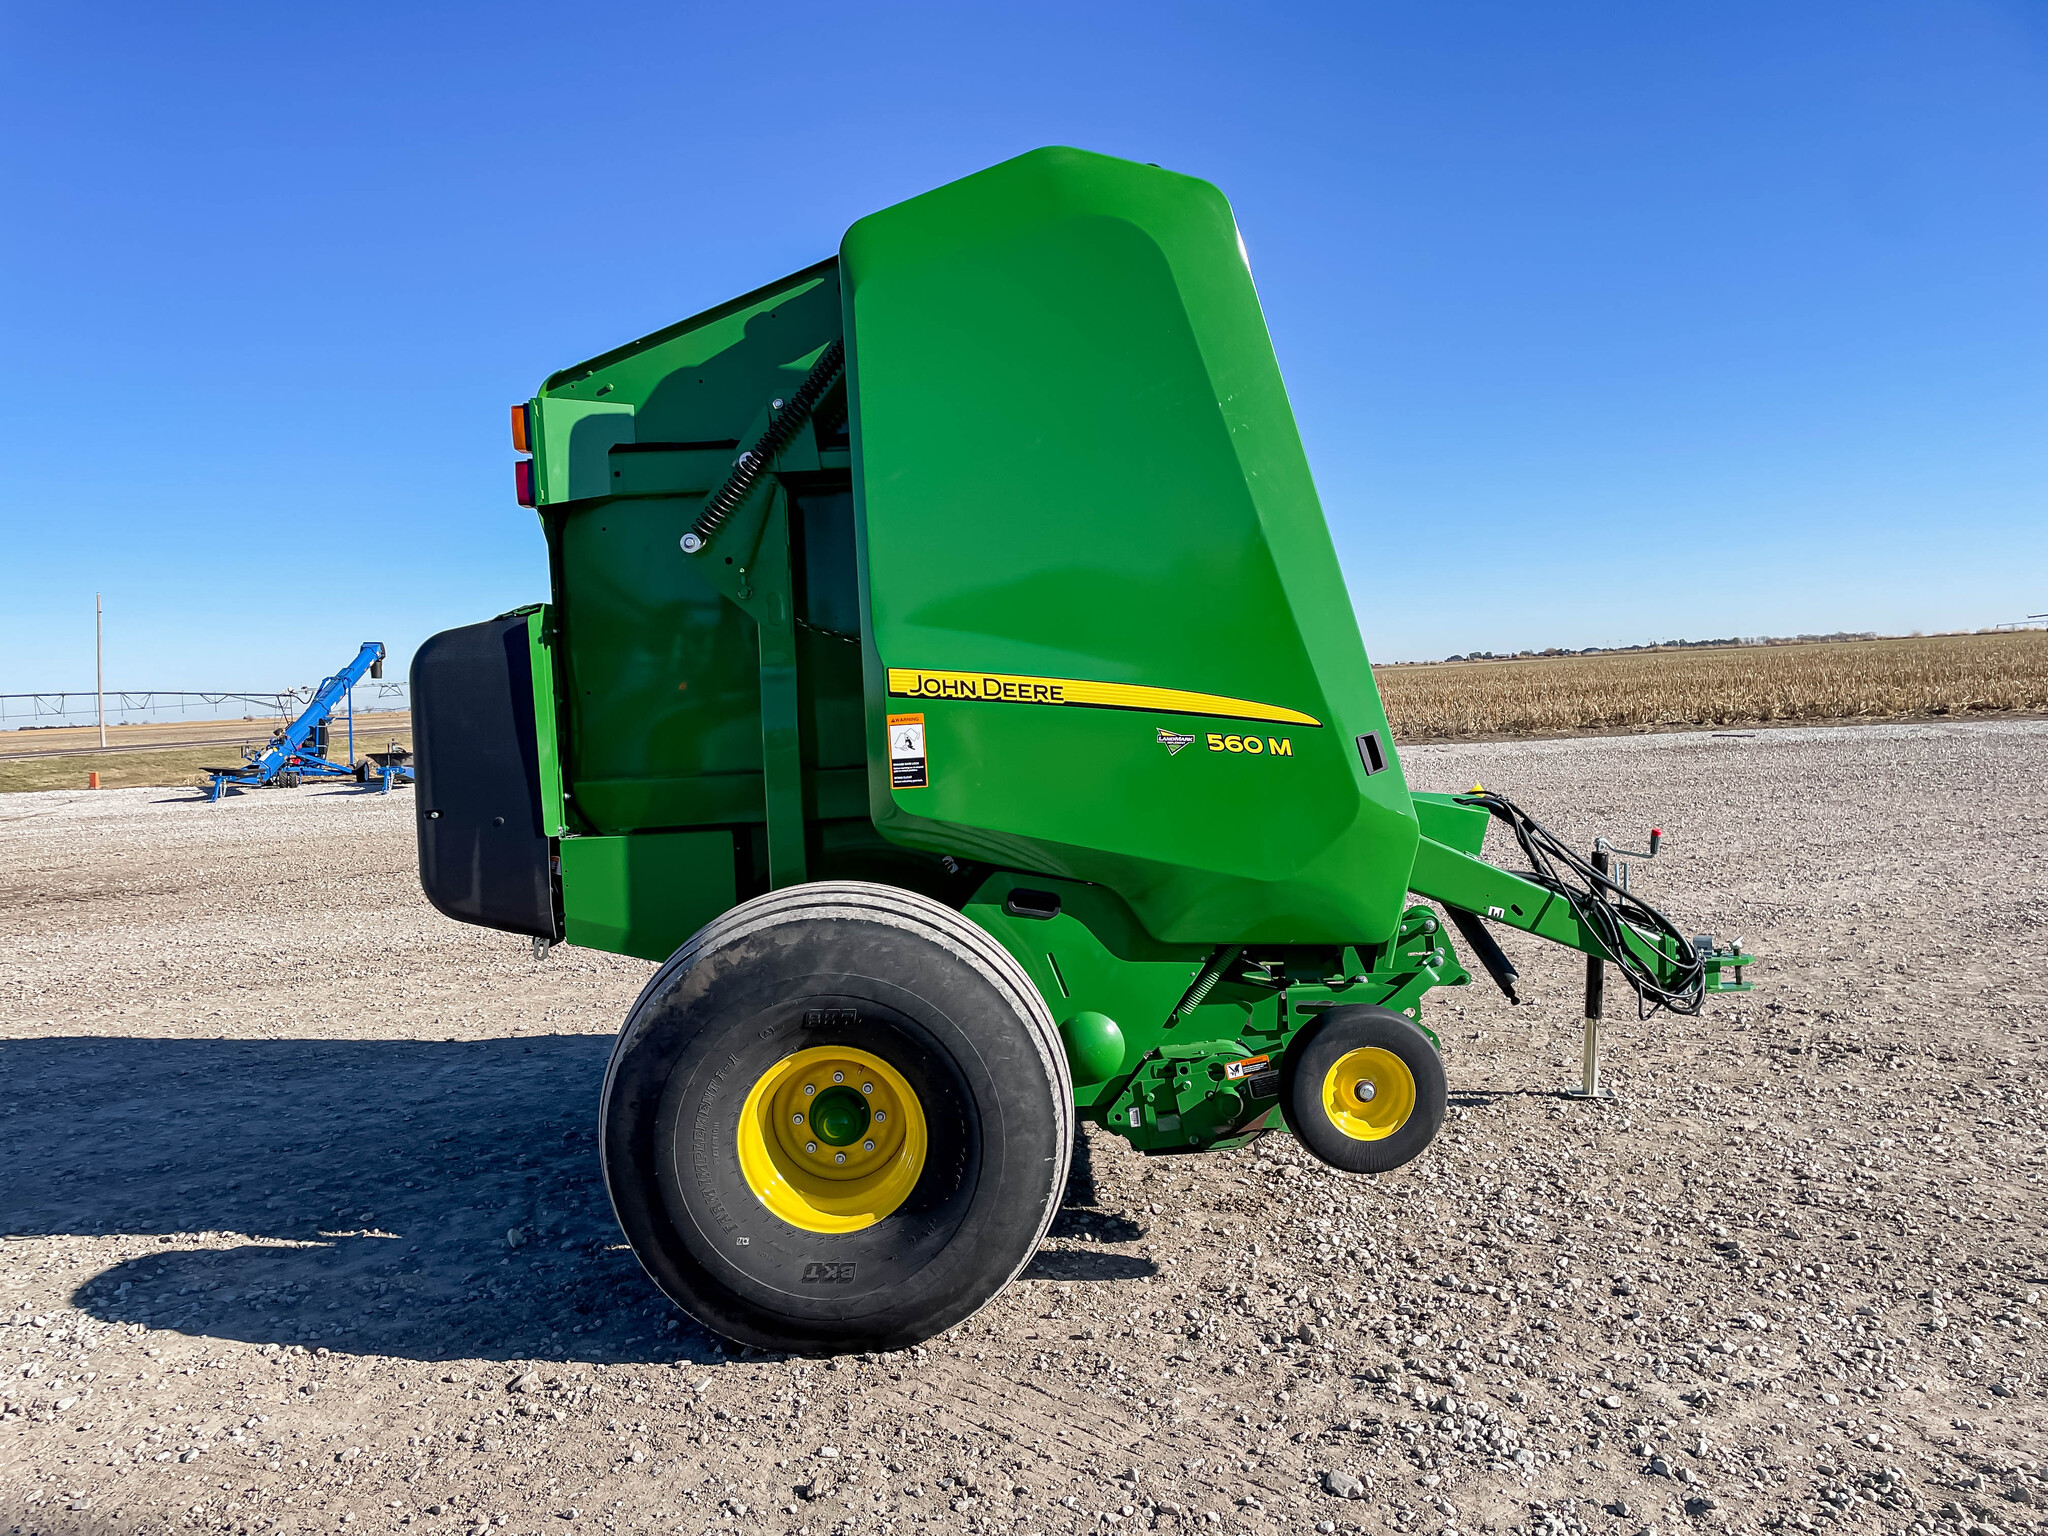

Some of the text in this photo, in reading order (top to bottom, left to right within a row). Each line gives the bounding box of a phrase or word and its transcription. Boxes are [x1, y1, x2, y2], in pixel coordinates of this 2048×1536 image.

[909, 674, 1065, 701] JOHN DEERE
[1205, 732, 1293, 757] 560 M
[804, 1263, 855, 1282] BKT
